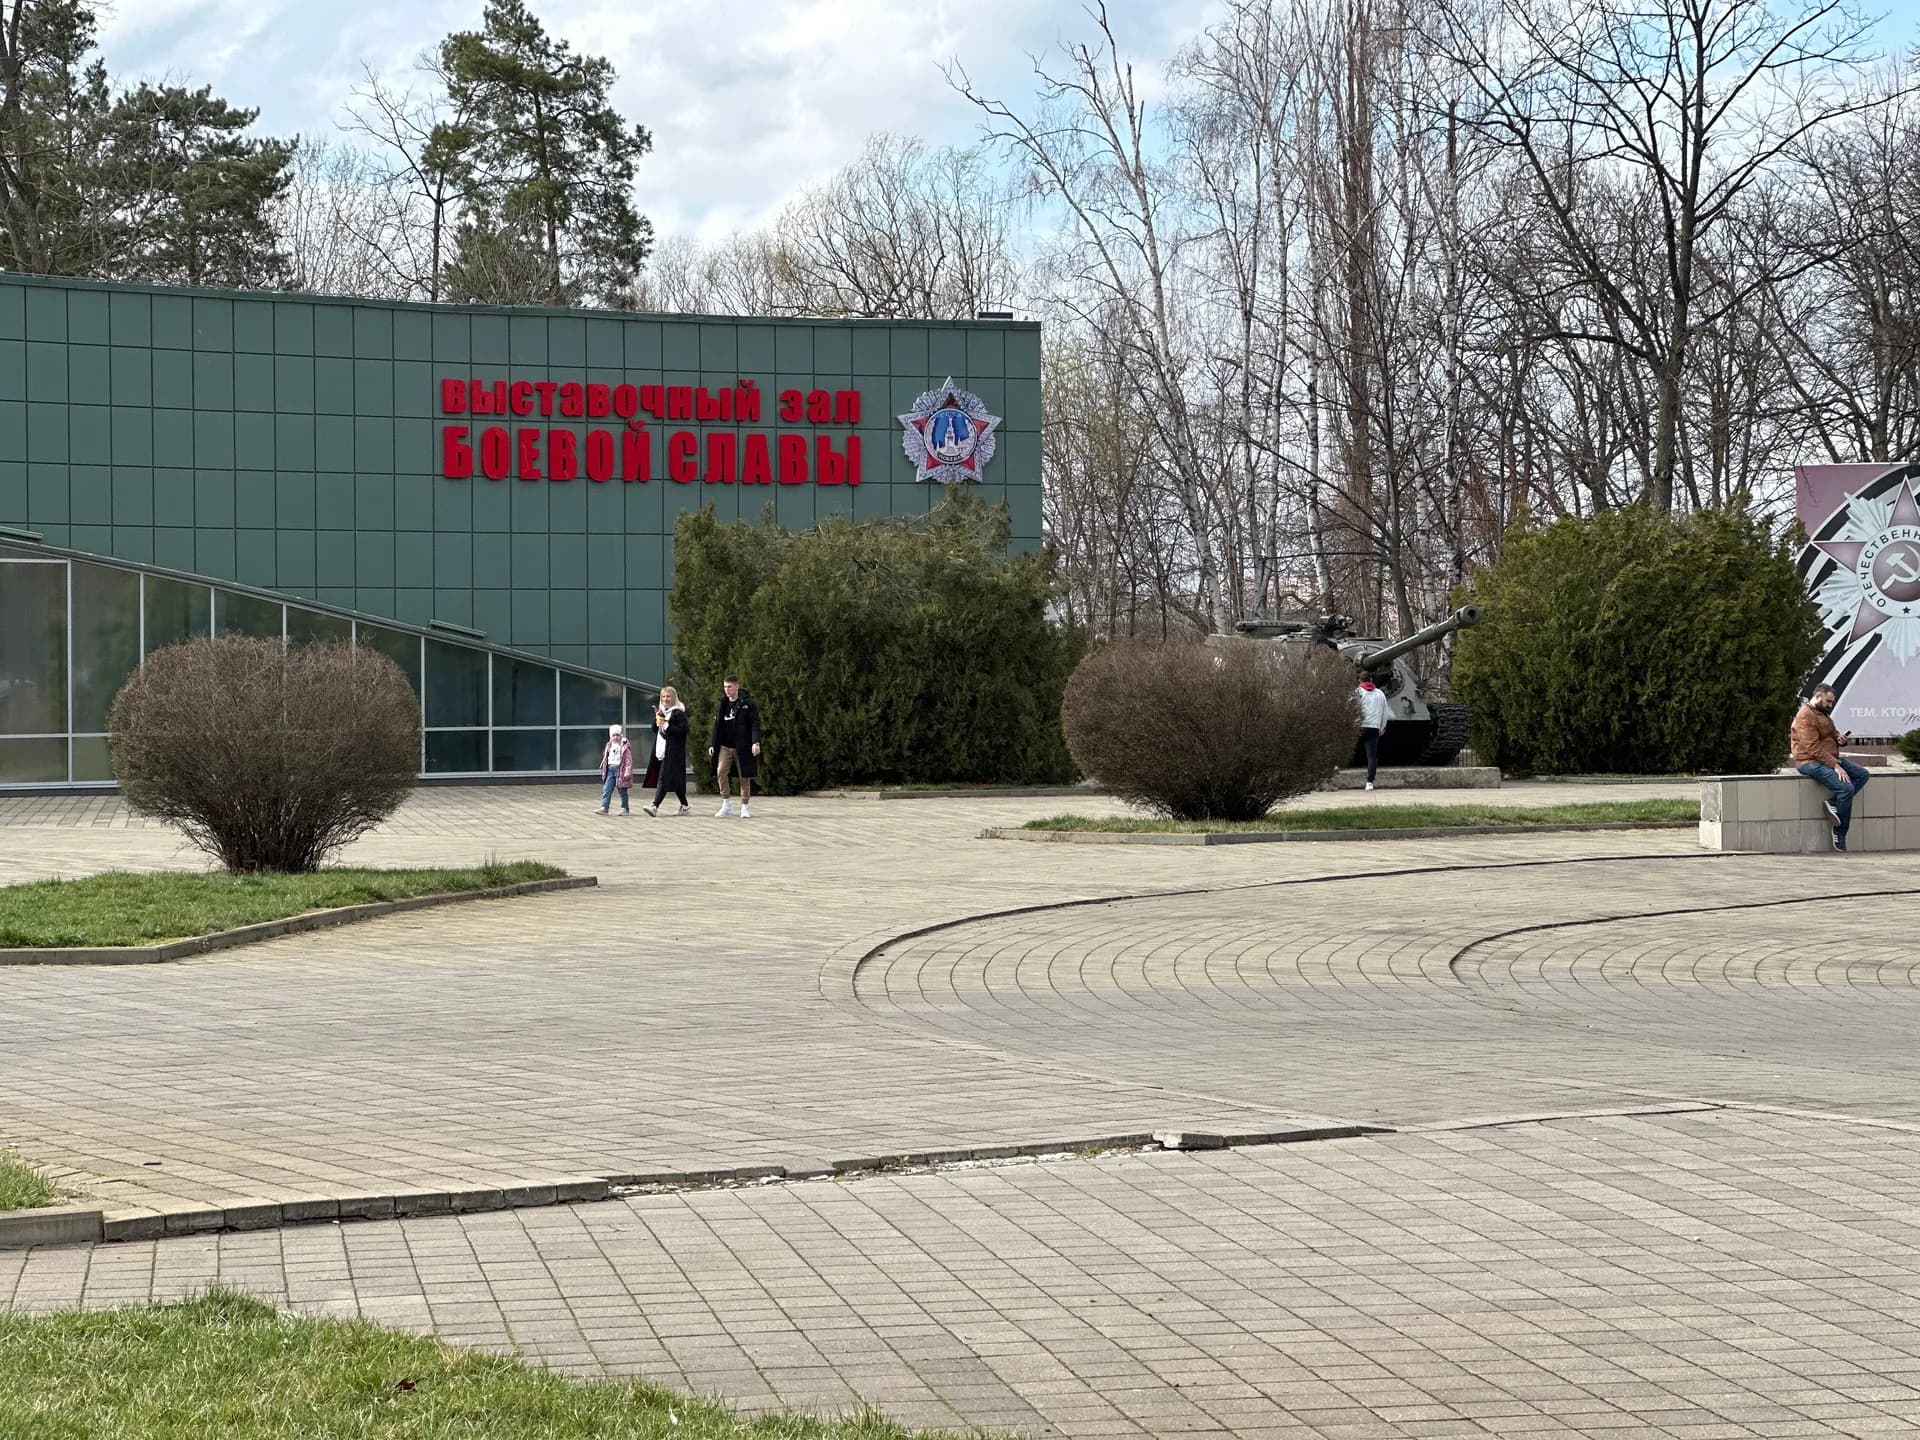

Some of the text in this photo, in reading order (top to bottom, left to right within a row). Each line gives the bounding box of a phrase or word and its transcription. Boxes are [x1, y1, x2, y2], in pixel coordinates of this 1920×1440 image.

[443, 420, 861, 486] БОЕВОЙ СЛАВЫ
[1881, 707, 1906, 718] КТО
